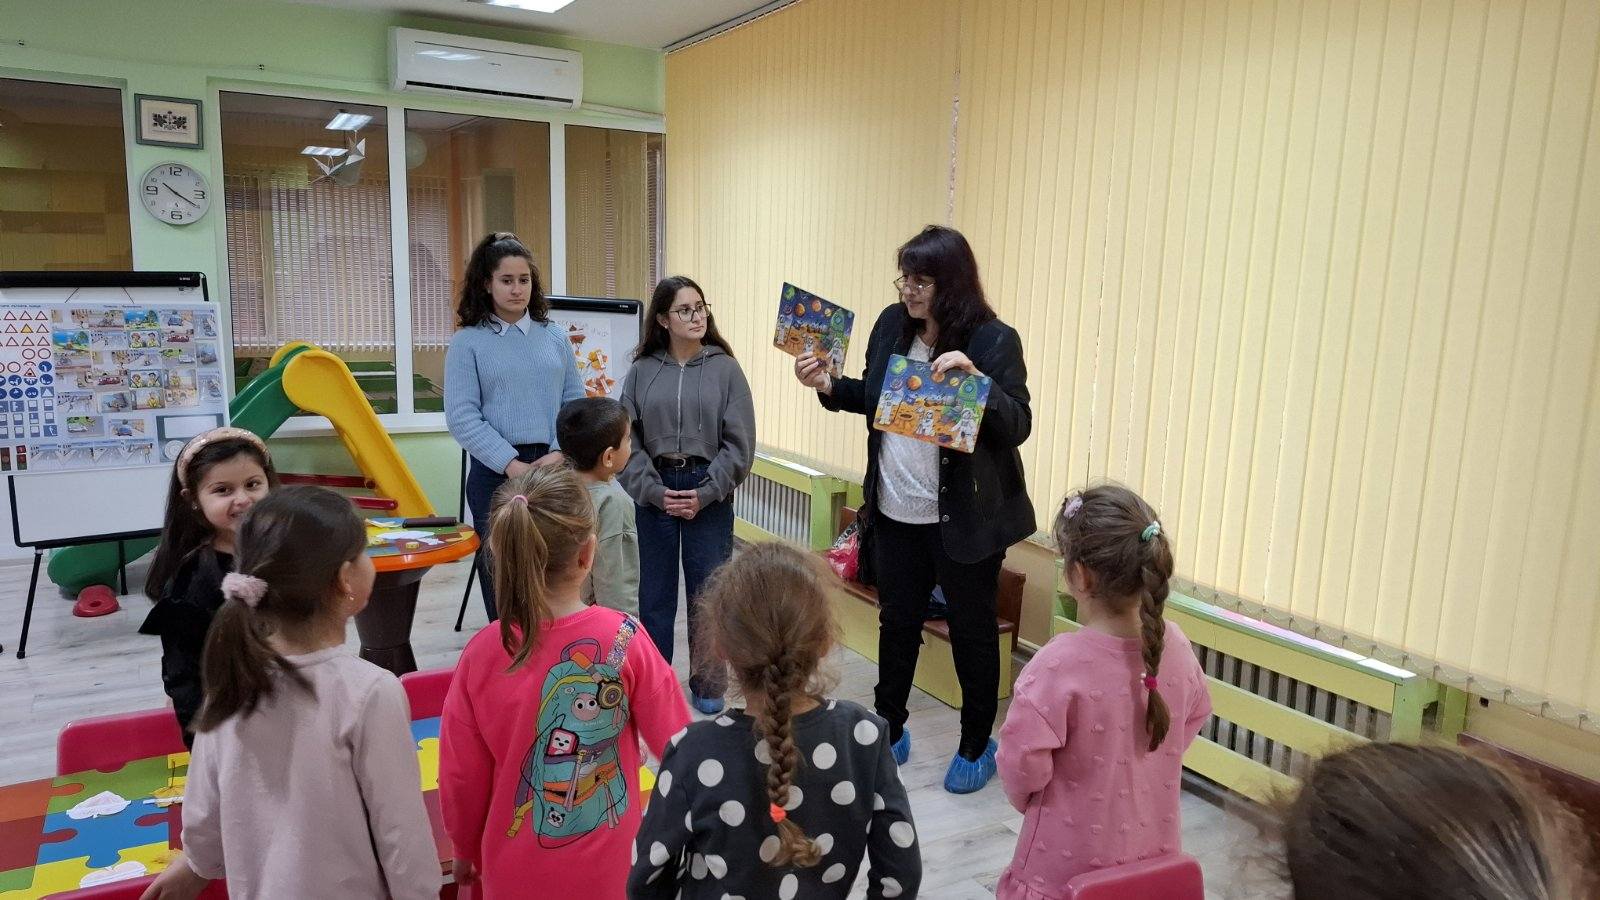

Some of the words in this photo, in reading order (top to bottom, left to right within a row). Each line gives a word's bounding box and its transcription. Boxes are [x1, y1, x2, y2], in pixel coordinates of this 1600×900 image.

[169, 166, 183, 176] 12
[146, 185, 158, 195] 9
[193, 189, 206, 200] 3
[170, 210, 183, 220] 6
